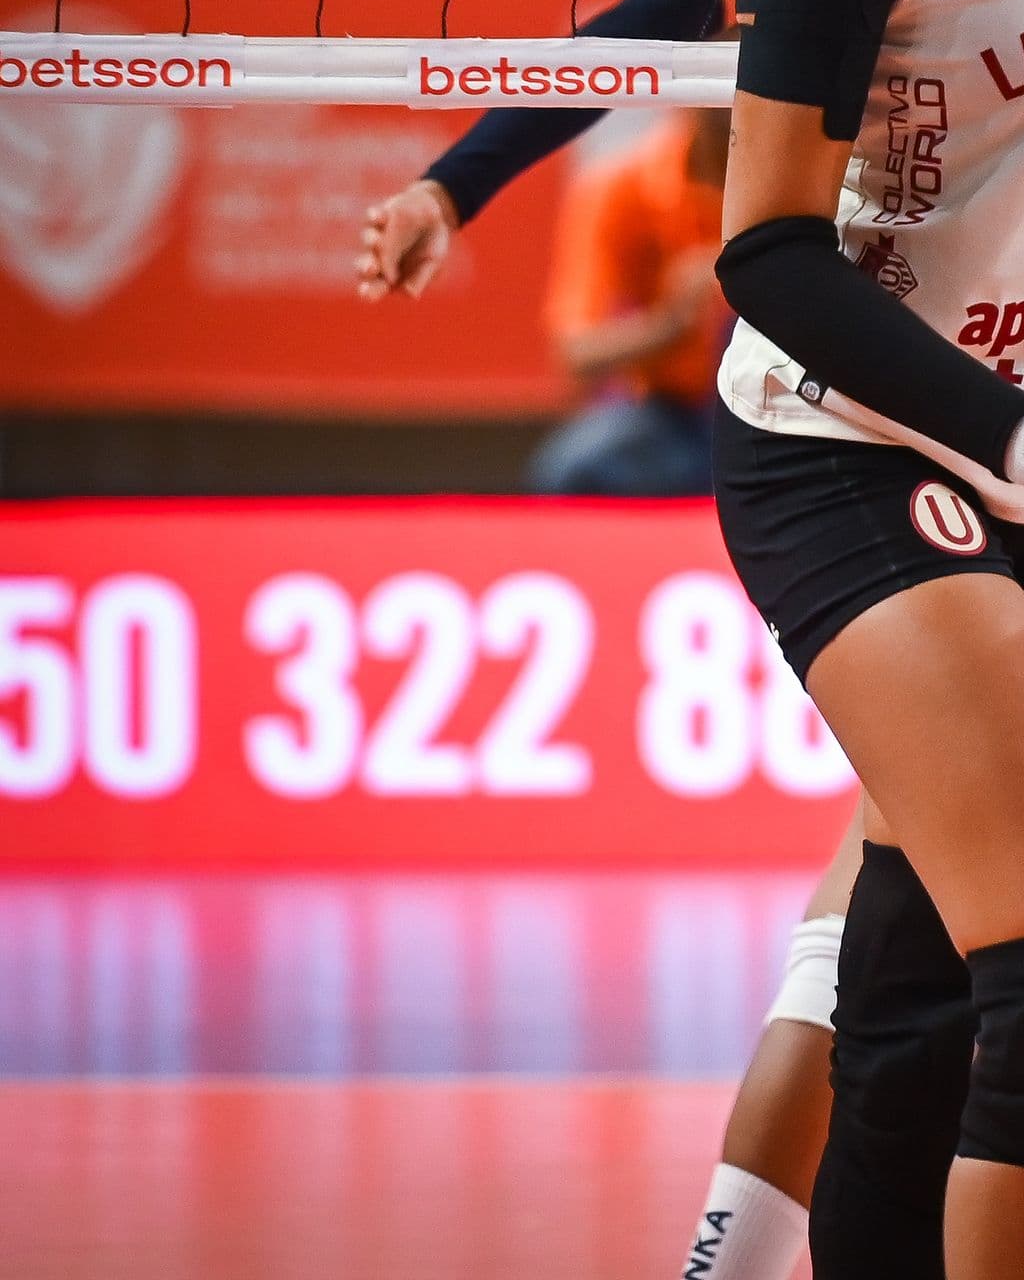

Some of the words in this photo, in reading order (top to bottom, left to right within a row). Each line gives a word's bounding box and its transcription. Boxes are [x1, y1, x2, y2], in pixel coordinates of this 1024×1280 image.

[419, 56, 660, 97] betsson
[893, 77, 948, 226] WORLD
[242, 569, 598, 799] 322
